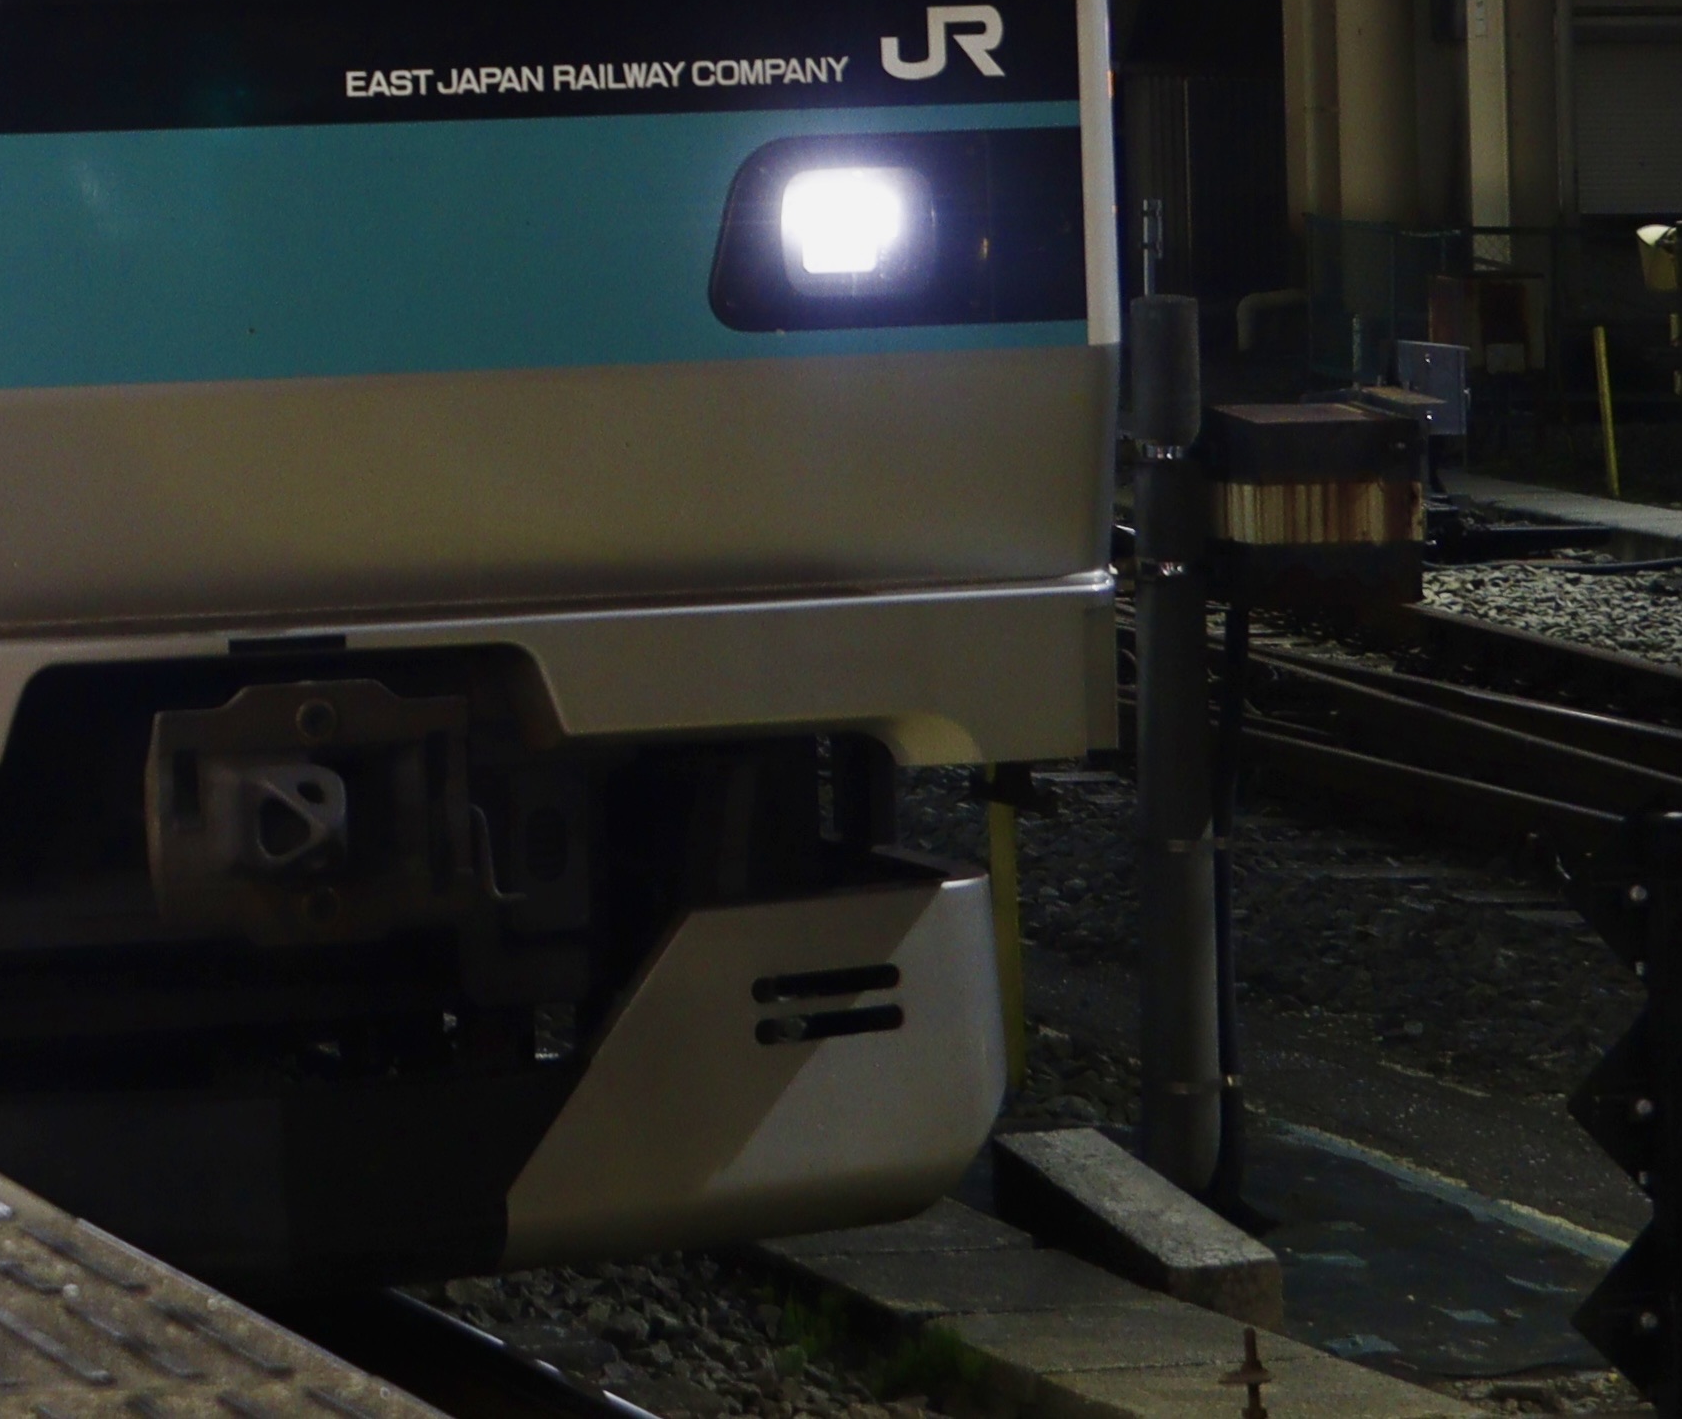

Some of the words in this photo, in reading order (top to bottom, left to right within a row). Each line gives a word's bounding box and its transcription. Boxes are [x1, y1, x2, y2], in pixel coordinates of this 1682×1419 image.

[880, 5, 1005, 80] JR
[345, 69, 434, 98] EAST
[436, 65, 545, 95] JAPAN
[552, 61, 686, 92] RAILWAY
[691, 55, 850, 87] COMPANY
